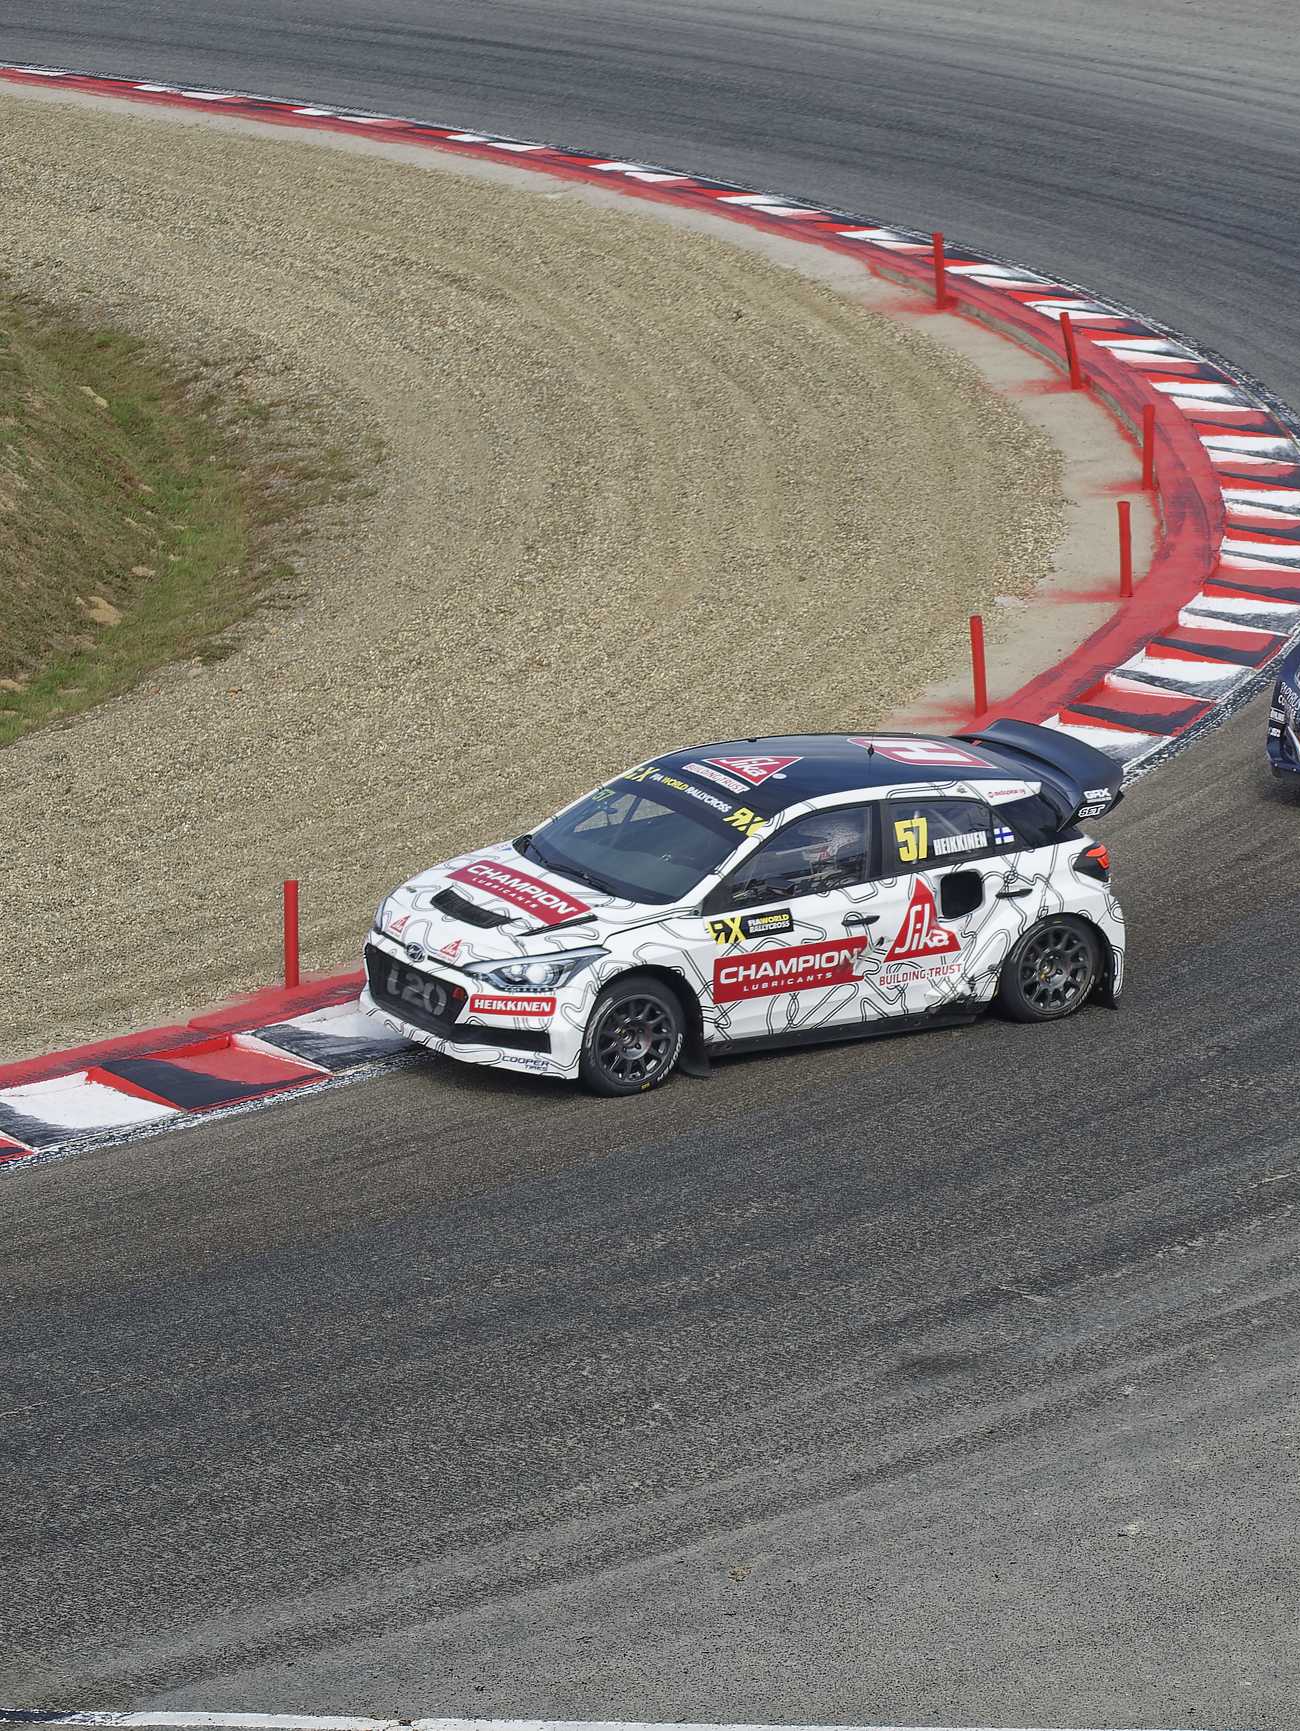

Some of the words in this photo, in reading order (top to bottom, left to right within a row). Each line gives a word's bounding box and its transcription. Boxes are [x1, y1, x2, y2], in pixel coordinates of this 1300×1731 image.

[894, 817, 928, 862] 57
[932, 830, 989, 856] HEIKKINEN
[466, 864, 577, 914] CHAMPION
[894, 903, 951, 955] Sika
[719, 949, 859, 985] CHAMPION
[880, 969, 926, 986] BUILDING
[928, 963, 962, 978] TRUST
[743, 971, 833, 993] LUBRICANTS
[473, 998, 552, 1013] HEIKKINEN
[502, 1055, 550, 1067] COOPER
